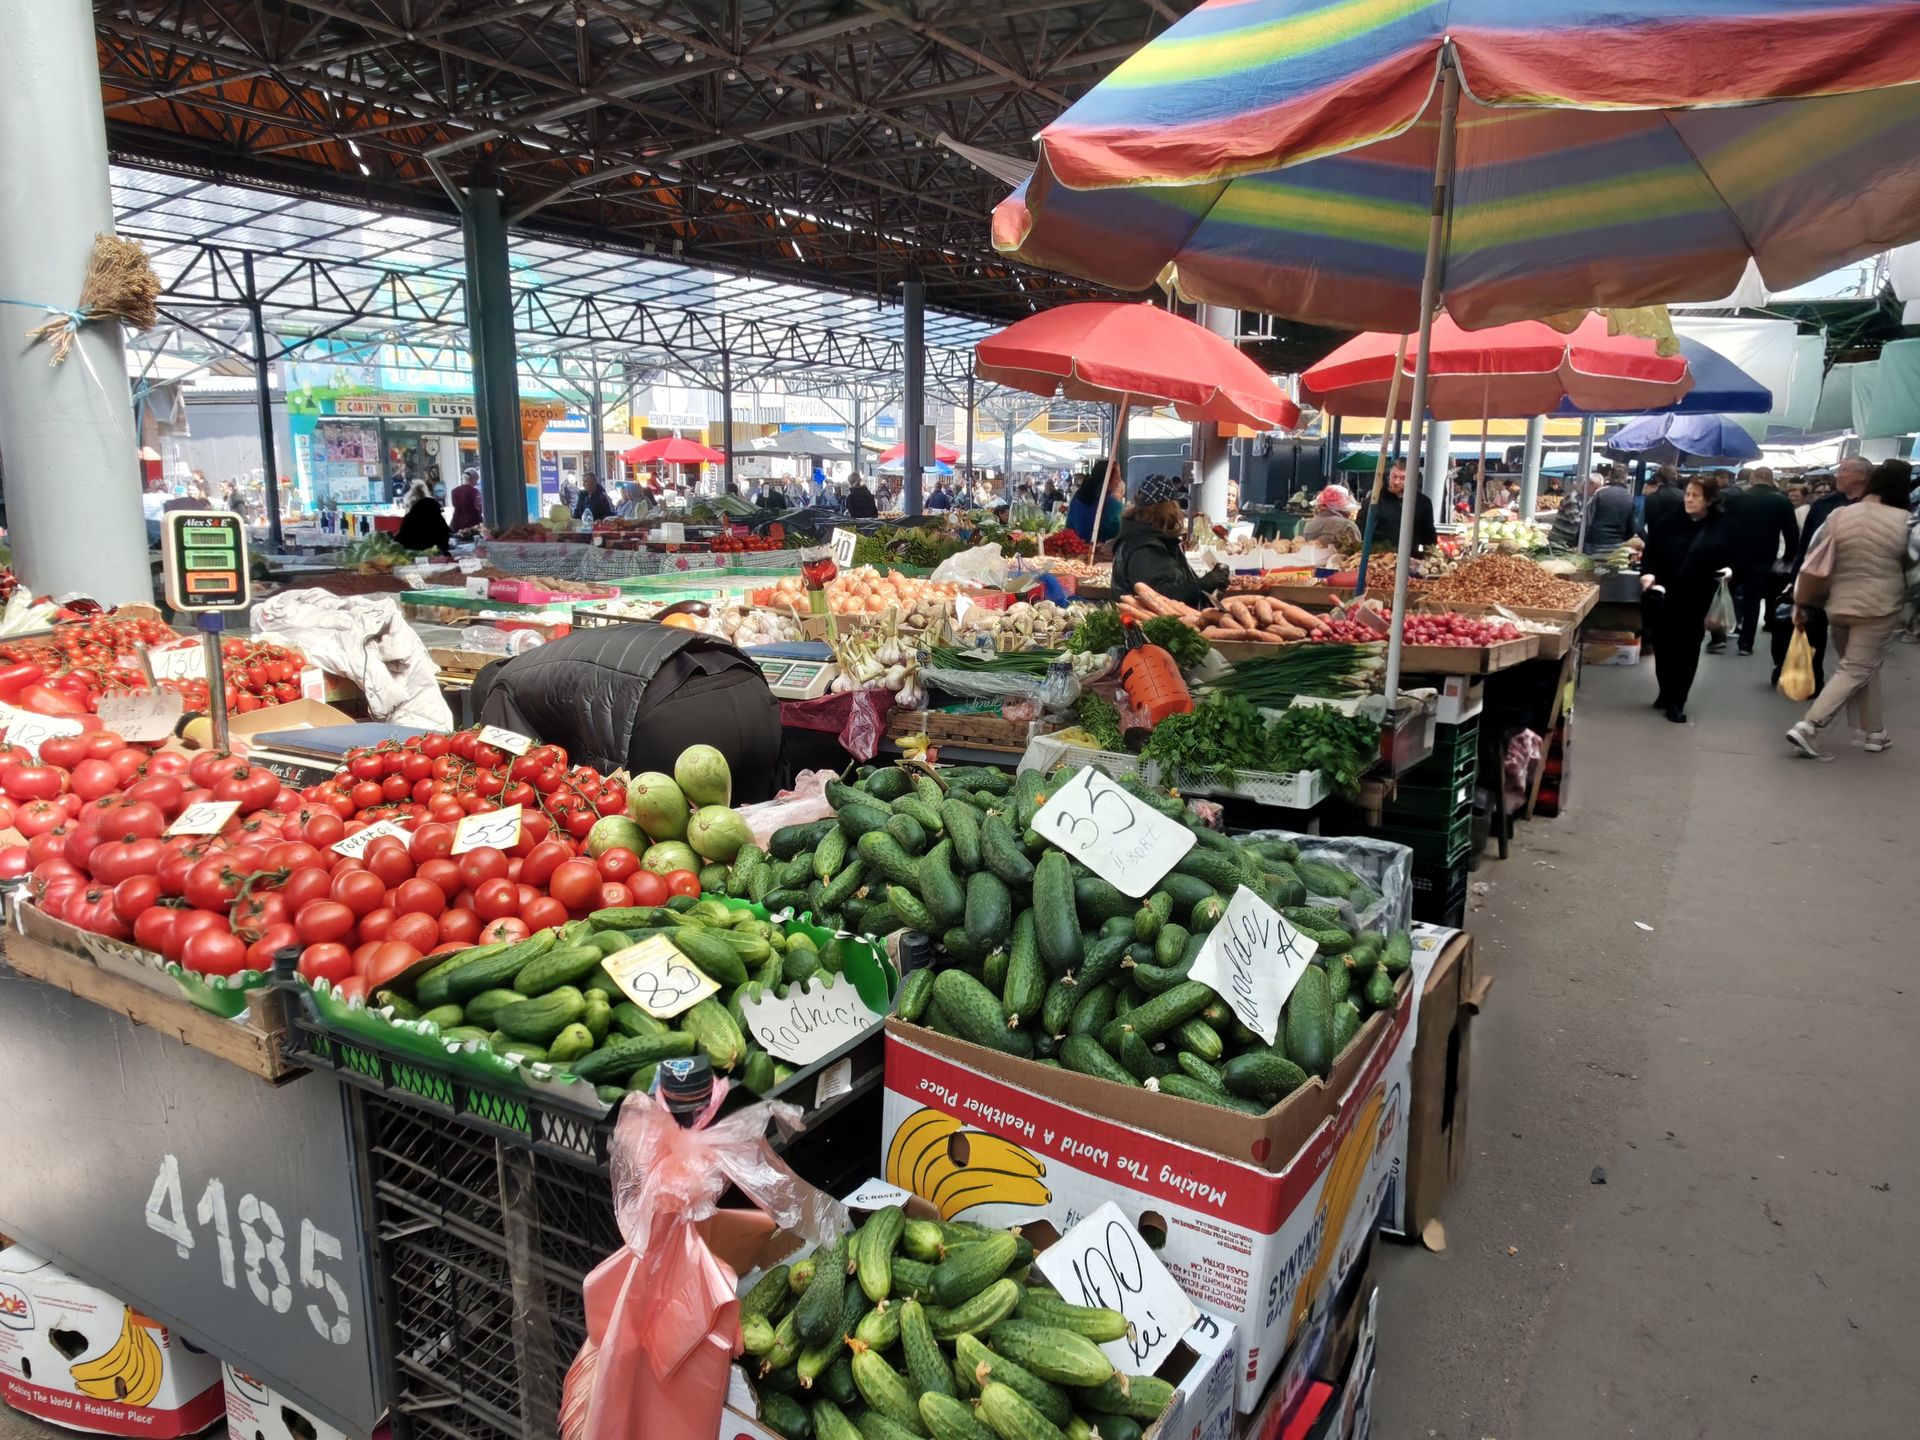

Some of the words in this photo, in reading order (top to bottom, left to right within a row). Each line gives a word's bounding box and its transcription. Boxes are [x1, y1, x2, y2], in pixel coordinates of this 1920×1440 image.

[183, 518, 205, 527] Alex
[1057, 767, 1136, 850] 35
[461, 816, 522, 845] 55
[632, 952, 701, 1009] 85
[920, 1078, 957, 1107] Place
[963, 1099, 1036, 1139] Healthier
[1043, 1131, 1055, 1146] A
[1060, 1136, 1109, 1168] World
[1116, 1155, 1149, 1182] The
[1159, 1164, 1228, 1208] Making
[145, 1154, 352, 1345] 4185
[8, 1381, 32, 1401] Making
[32, 1389, 48, 1403] The
[49, 1394, 73, 1411] World
[74, 1400, 82, 1411] A
[84, 1403, 125, 1420] Healthier
[127, 1410, 153, 1425] Place
